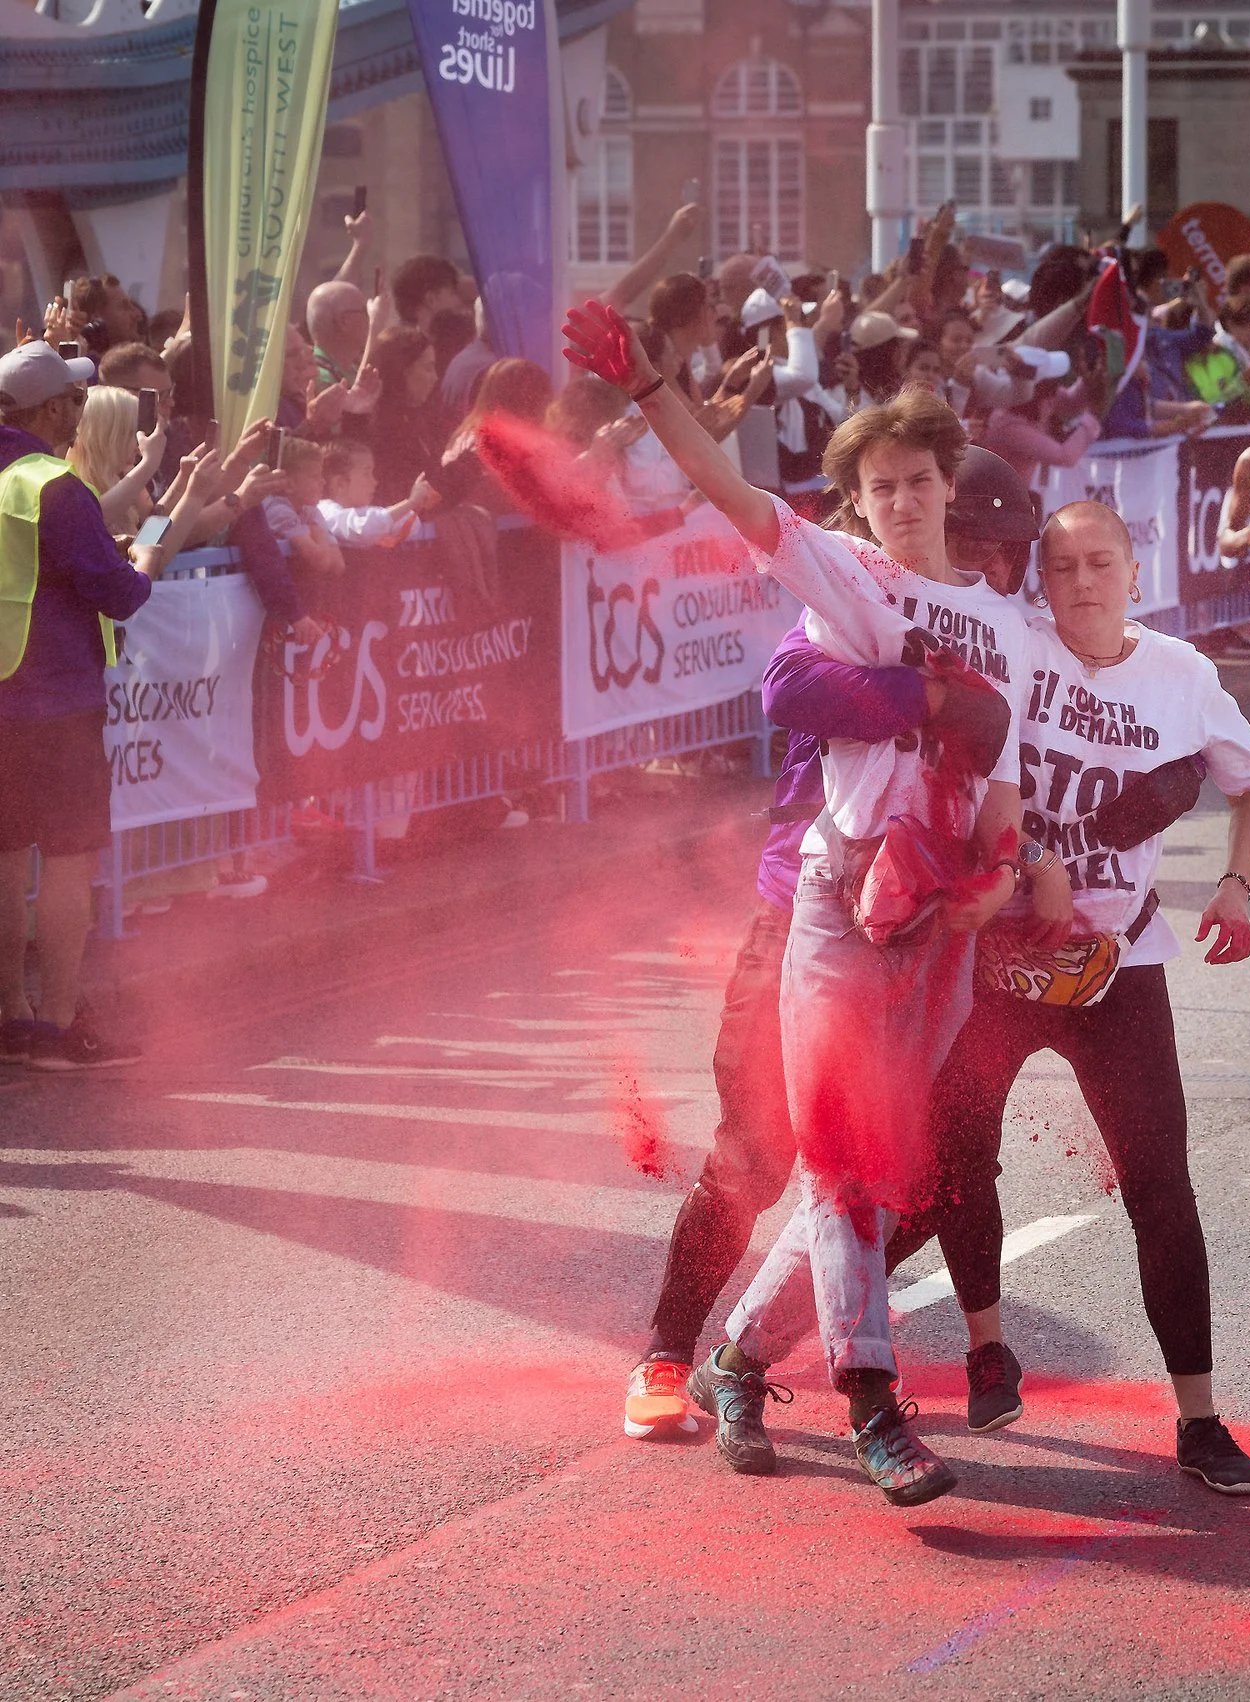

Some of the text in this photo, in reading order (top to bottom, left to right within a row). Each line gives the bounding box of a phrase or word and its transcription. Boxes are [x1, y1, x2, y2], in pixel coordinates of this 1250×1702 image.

[242, 6, 264, 115] hospice
[276, 12, 299, 114] WEST
[397, 615, 533, 679] CONSULTANCY
[927, 602, 997, 651] YOUTH
[673, 629, 745, 679] SERVICES
[397, 683, 488, 734] SERVICES
[1058, 704, 1161, 751] DEMAND
[1067, 684, 1137, 724] YOUTH
